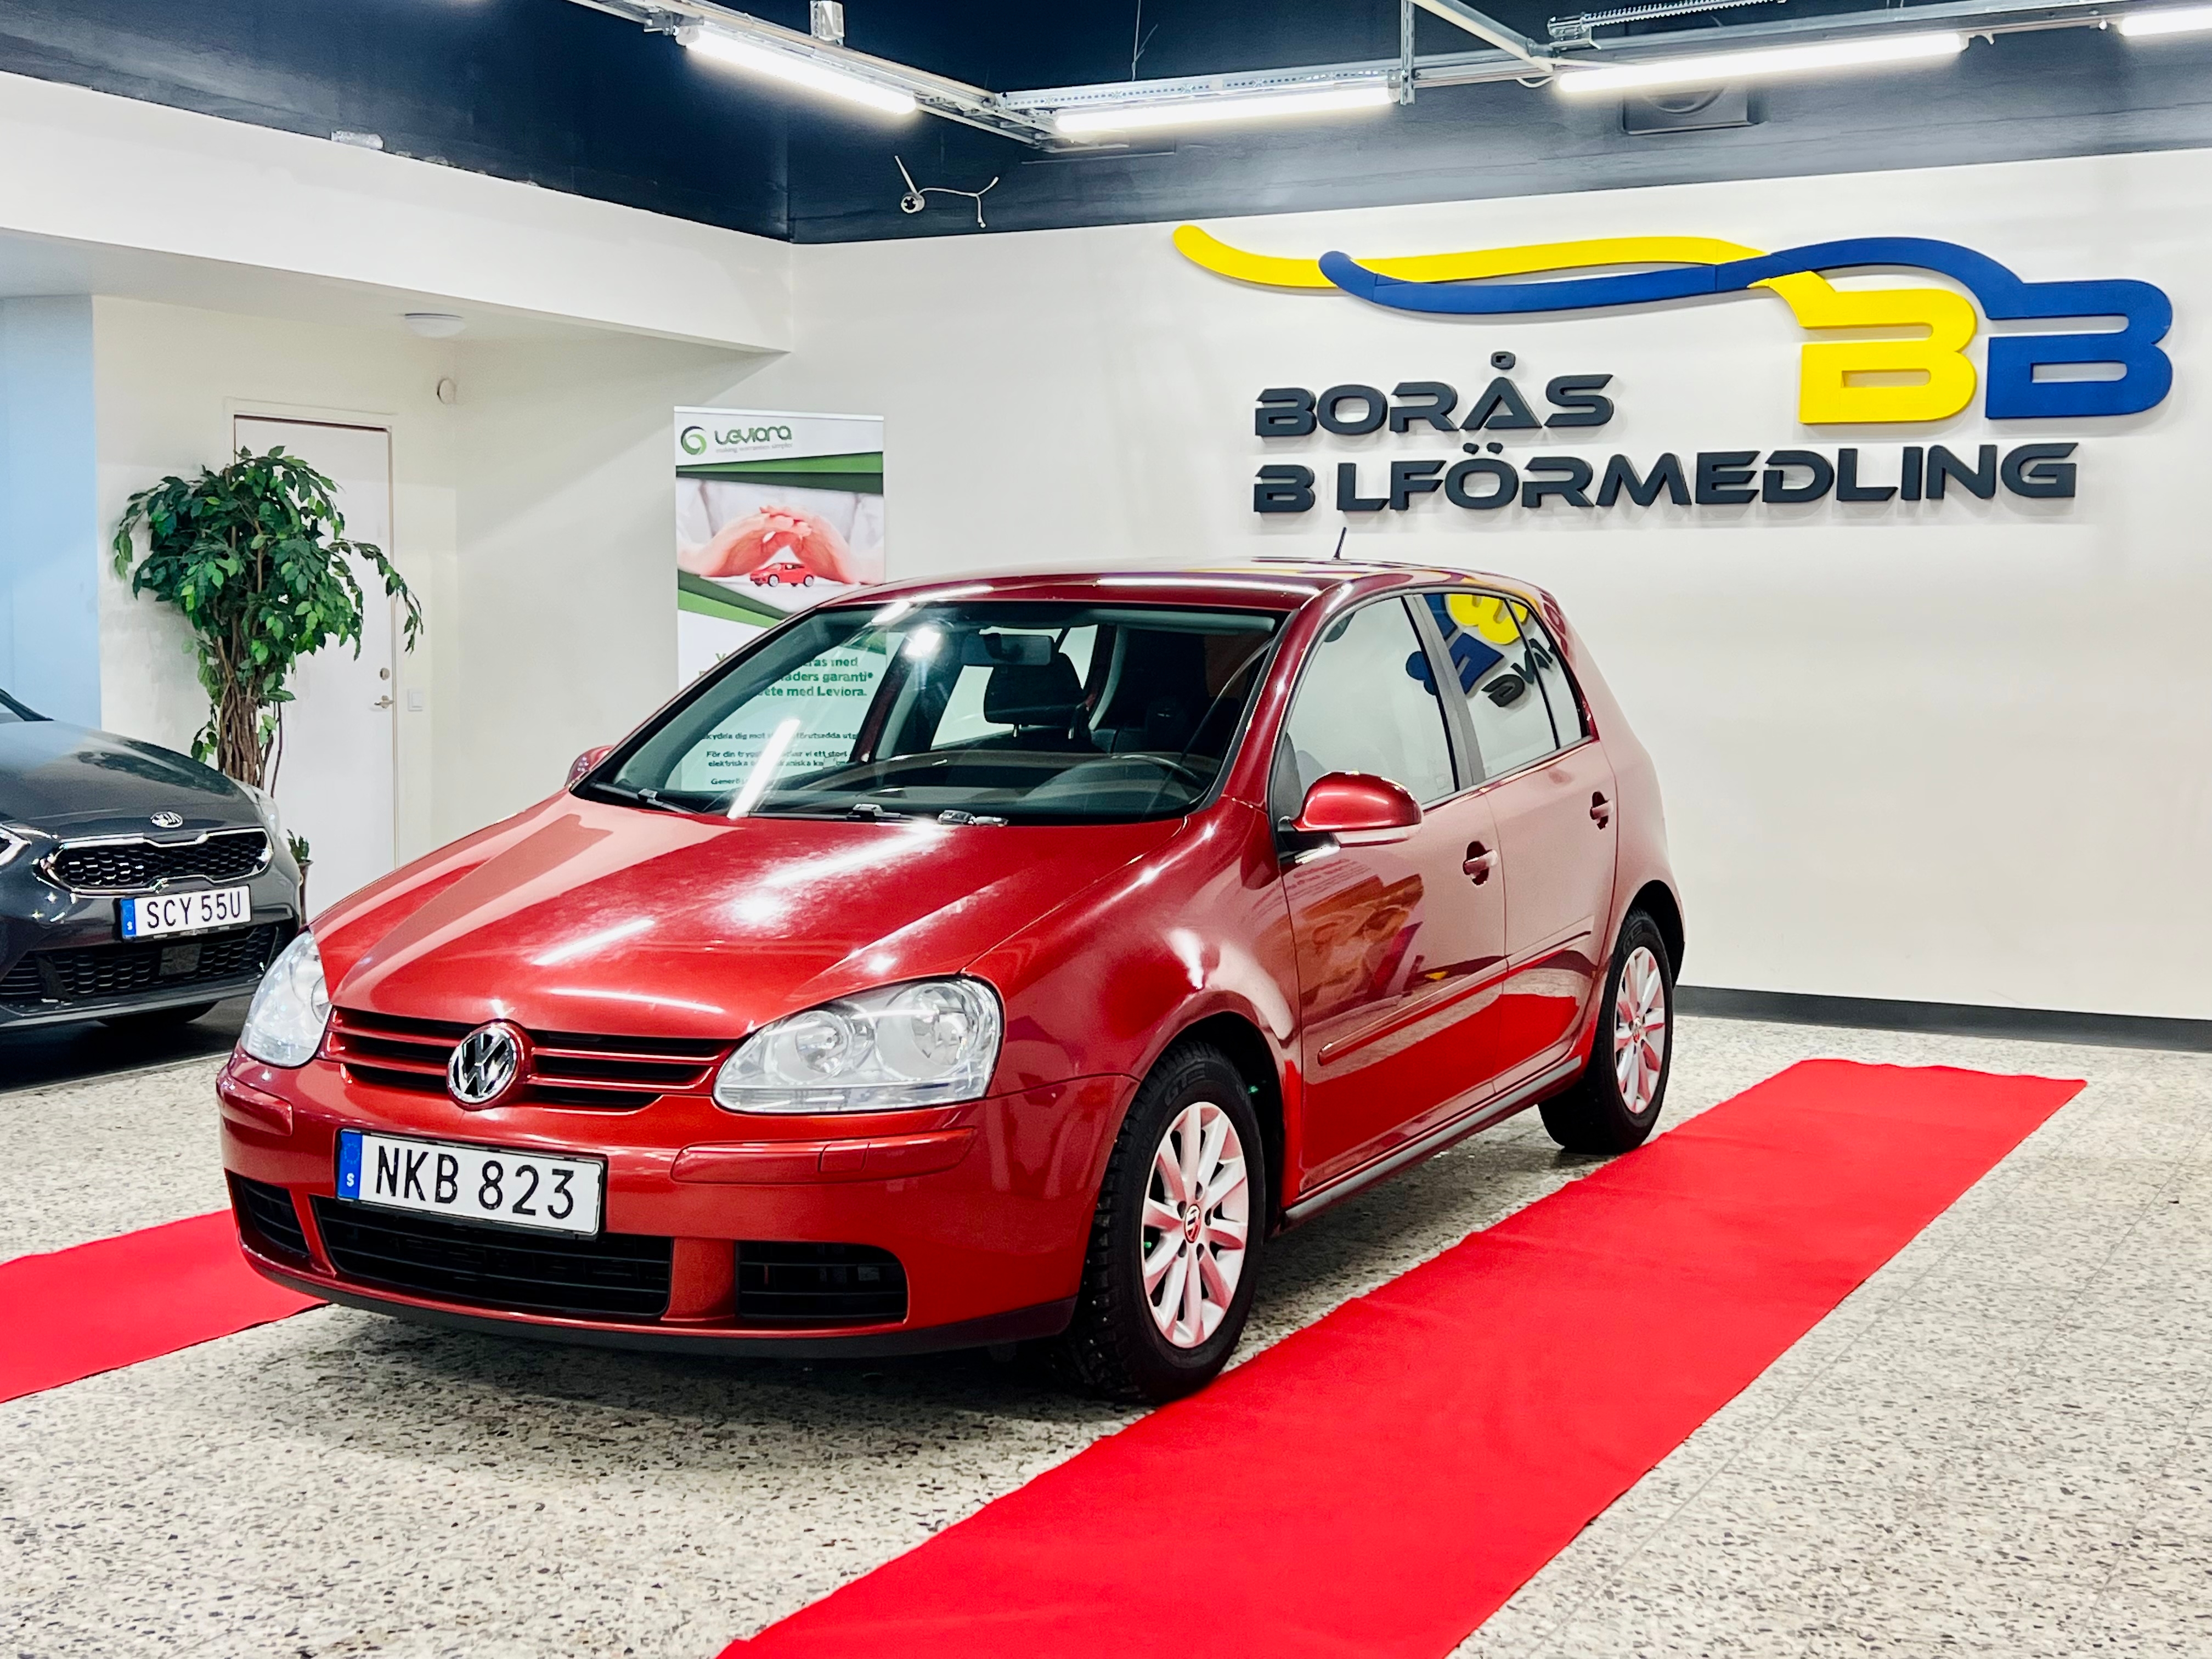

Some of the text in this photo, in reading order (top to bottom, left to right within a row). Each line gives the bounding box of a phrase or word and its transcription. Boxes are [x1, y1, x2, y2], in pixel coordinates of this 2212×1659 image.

[1255, 351, 1614, 437] BORÅS
[831, 657, 859, 667] med
[787, 686, 814, 696] med
[817, 686, 867, 696] Leviora.
[146, 890, 241, 929] SCY 55U
[346, 1145, 574, 1220] S NKB 823
